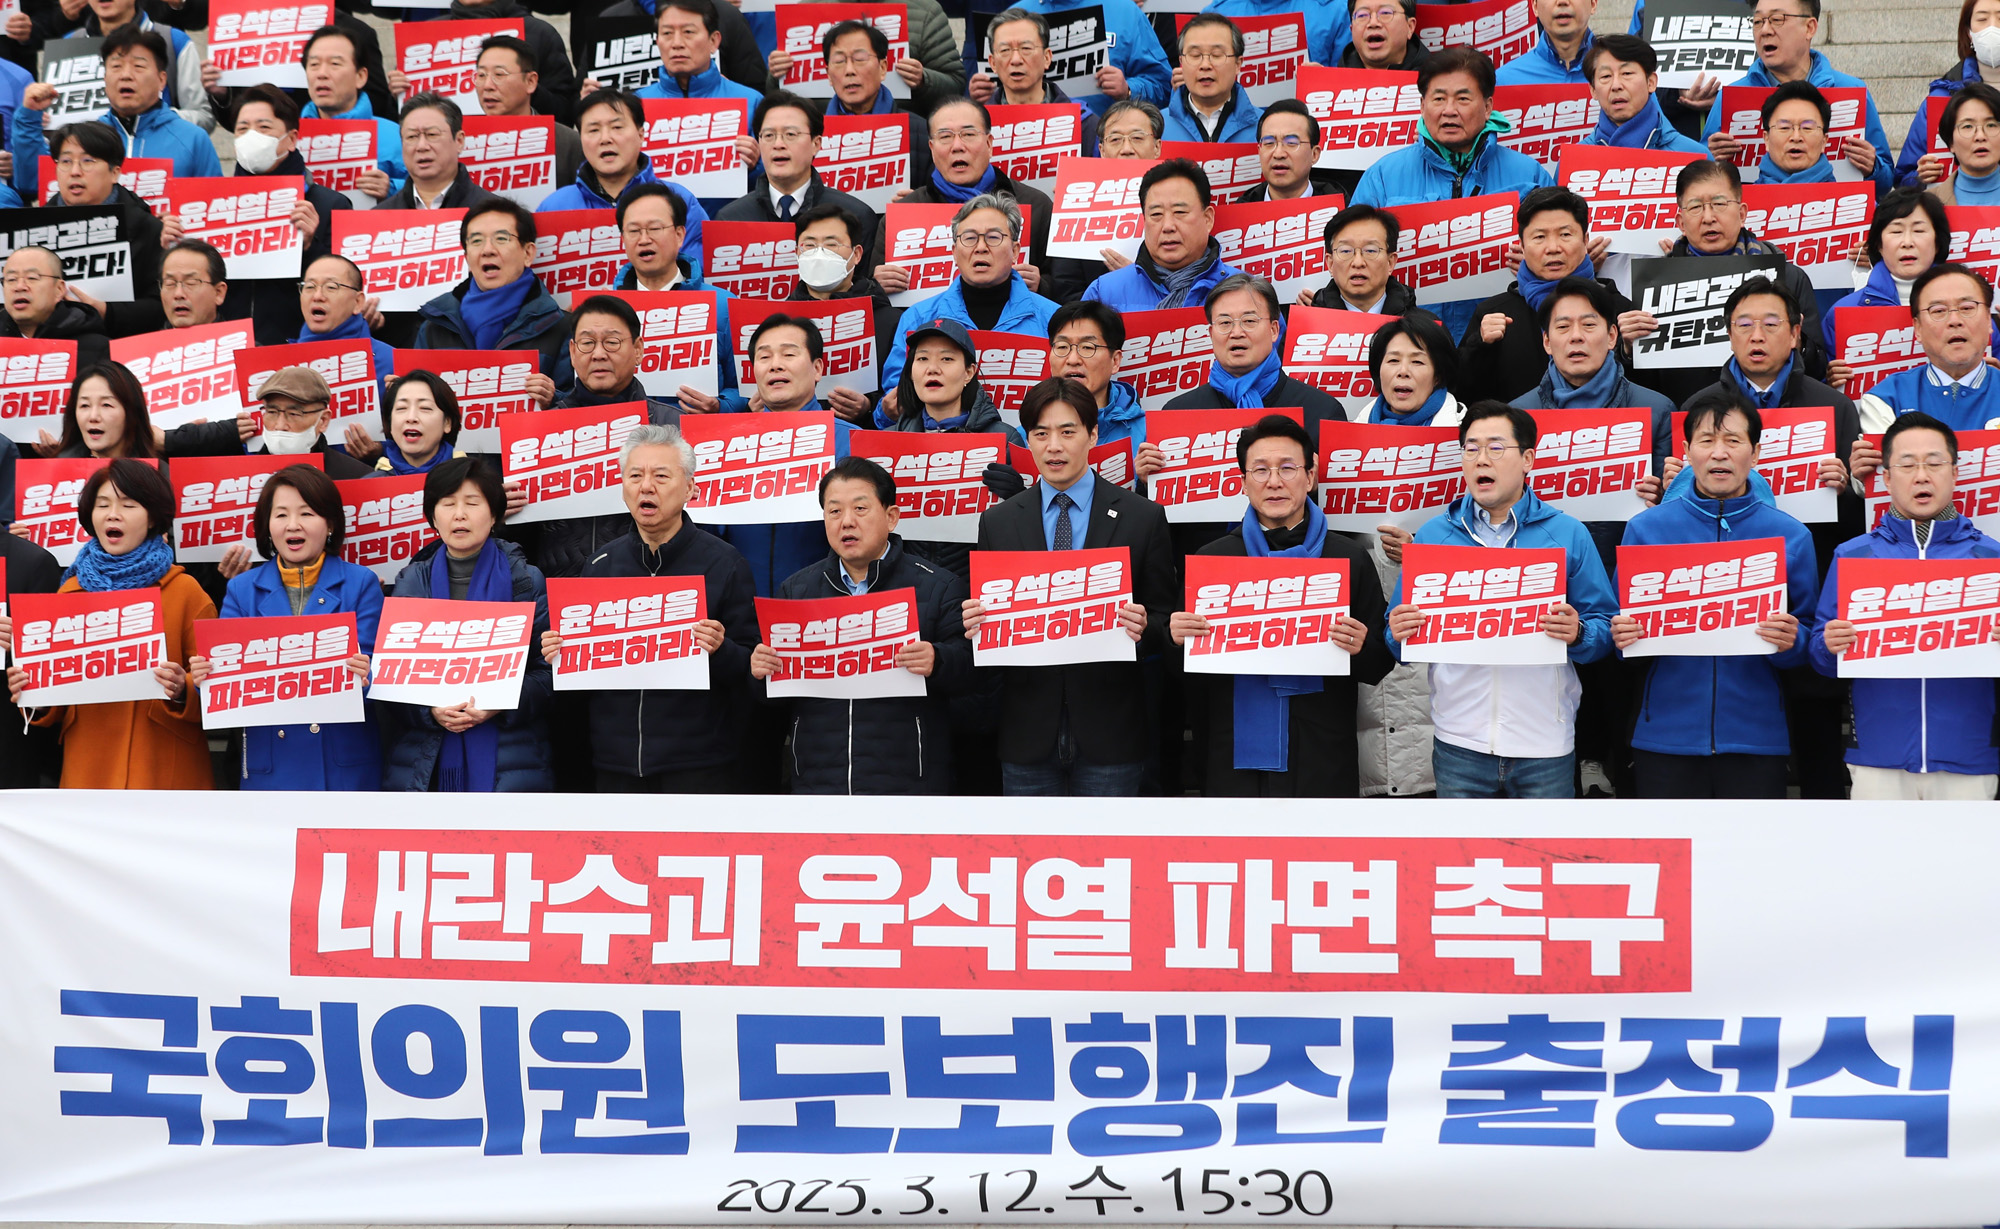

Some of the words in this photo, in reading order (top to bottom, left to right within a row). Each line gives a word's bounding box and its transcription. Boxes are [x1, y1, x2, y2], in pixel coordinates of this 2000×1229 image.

[214, 4, 328, 41] 윤석열을
[1247, 25, 1298, 52] 열을
[1420, 2, 1529, 51] 윤석열을
[404, 29, 518, 69] 윤석열
[595, 33, 661, 68] 내란
[49, 54, 104, 84] 내란
[642, 110, 741, 147] 석열을
[989, 115, 1074, 149] 석열을
[1729, 99, 1859, 135] 윤을
[301, 131, 371, 163] 열을
[464, 127, 548, 161] 석열을
[651, 146, 741, 178] 면하라!
[178, 187, 299, 229] 윤석열을
[1588, 203, 1680, 232] 면하라
[202, 223, 298, 258] 면하라!
[341, 219, 463, 261] 윤석열을
[535, 225, 624, 261] 윤석열
[1054, 217, 1145, 243] 파면하
[62, 250, 126, 280] 한다!
[711, 239, 797, 274] 윤석열
[362, 261, 465, 292] 면하라!
[639, 303, 710, 338] 열을
[637, 340, 713, 374] 하라!
[1122, 323, 1215, 365] 윤석열
[440, 363, 534, 397] 석열을
[976, 349, 1047, 378] 열을
[509, 414, 641, 471] 윤석열을
[693, 424, 828, 471] 윤석열을
[1535, 421, 1644, 463] 석열을
[1758, 420, 1827, 457] 열을
[1326, 439, 1462, 479] 윤석열을
[22, 479, 86, 516] 윤석
[1153, 469, 1247, 507] 파면하
[1531, 462, 1647, 502] 면하라!
[979, 560, 1123, 609] 윤석열을
[1194, 572, 1342, 616] 윤석열을
[1411, 562, 1558, 606] 윤석열을
[1628, 551, 1778, 605] 윤석열을
[1846, 572, 2000, 621] 윤석열을
[22, 601, 155, 653] 윤석열을
[559, 588, 699, 636] 윤석열을
[769, 601, 909, 650] 윤석열을
[207, 625, 350, 672] 윤석열을
[383, 615, 527, 650] 윤석열을
[23, 641, 160, 691] 파면하라!
[373, 653, 521, 685] 파면하라!
[557, 628, 702, 675] 파면하라!
[206, 665, 354, 714] 파면하라!
[317, 850, 763, 967] 내란수괴
[794, 853, 1133, 973] 윤석열
[1166, 857, 1399, 975] 파면
[1431, 857, 1665, 977] 촉구
[53, 989, 690, 1156] 국회의원
[735, 1012, 1395, 1158] 도보행진
[1438, 1014, 1956, 1159] 출정식
